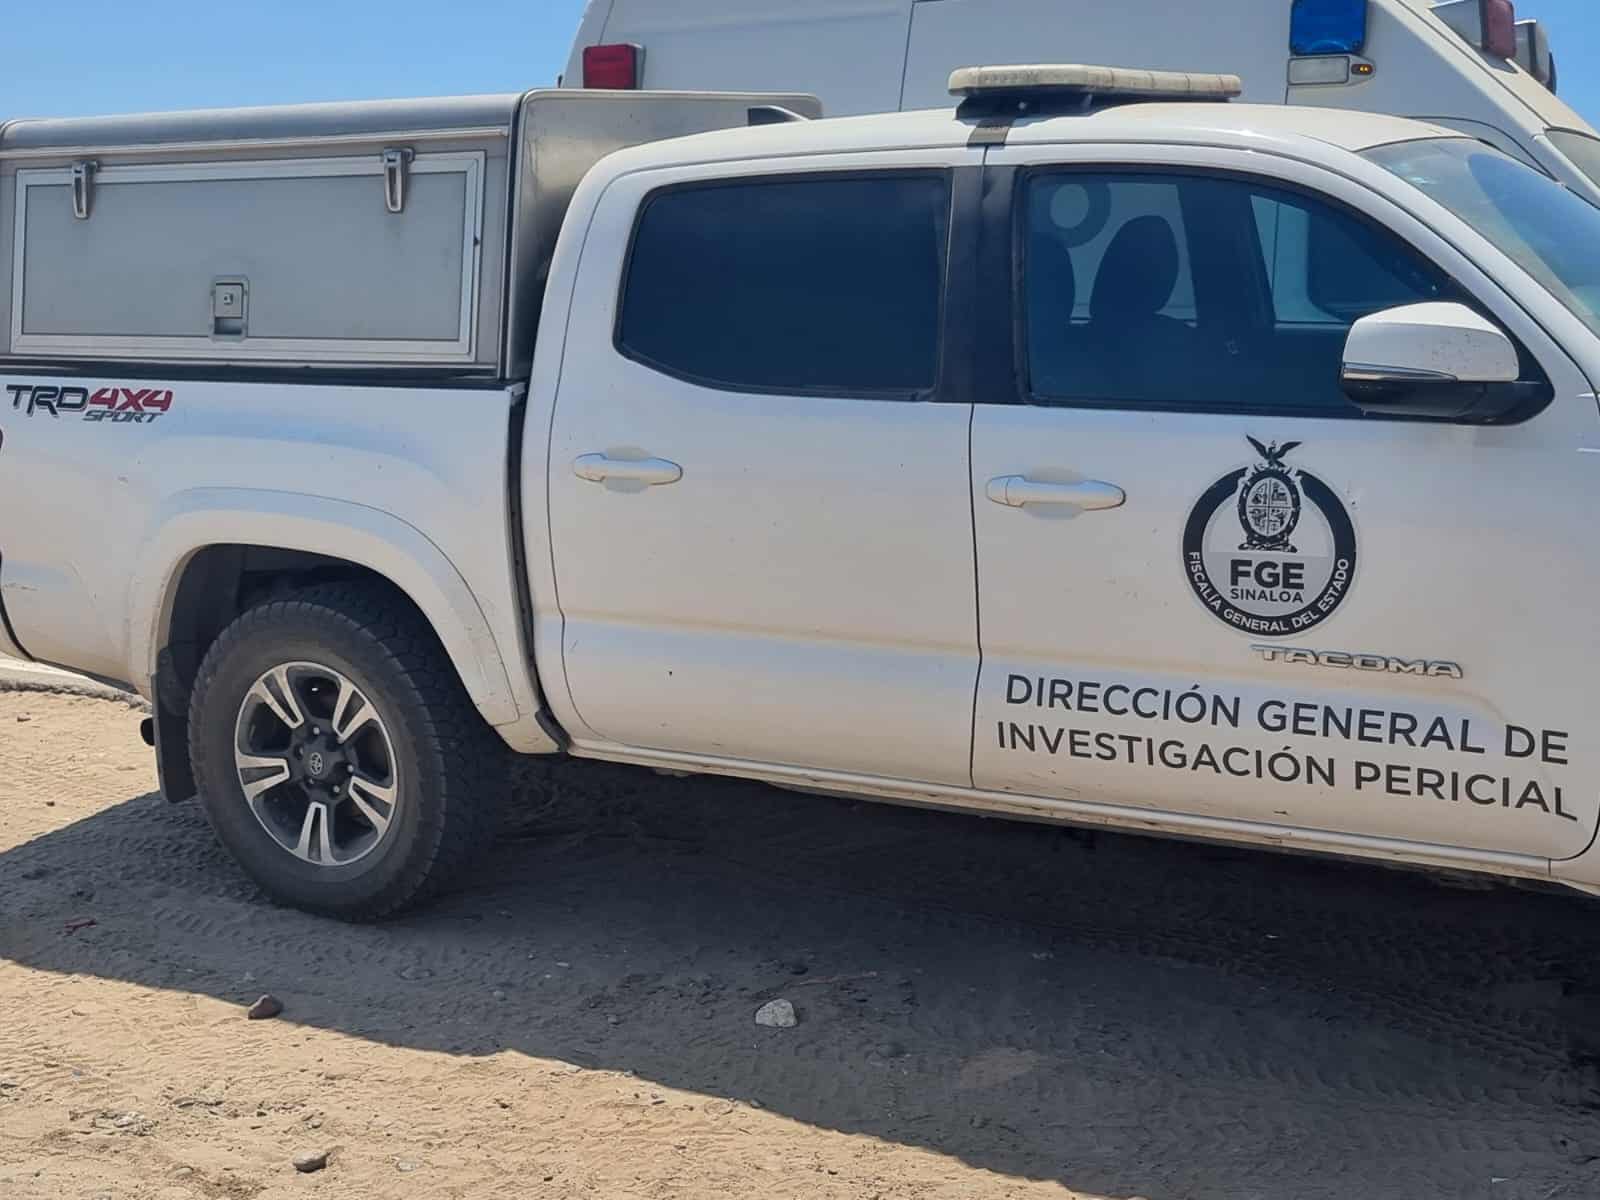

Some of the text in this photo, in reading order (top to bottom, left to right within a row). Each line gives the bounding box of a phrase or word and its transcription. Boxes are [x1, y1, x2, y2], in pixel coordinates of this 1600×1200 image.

[82, 409, 163, 424] SPORT
[1188, 551, 1350, 632] FISCALÍA GENERAL DEL ESTADO
[1230, 559, 1305, 590] FGE
[1230, 587, 1304, 603] SINALOA
[1251, 644, 1464, 679] TACOMA
[1006, 674, 1570, 765] DIRECCIÓN GENERAL DE
[997, 721, 1578, 821] INVESTIGACIÓN PERICIAL
